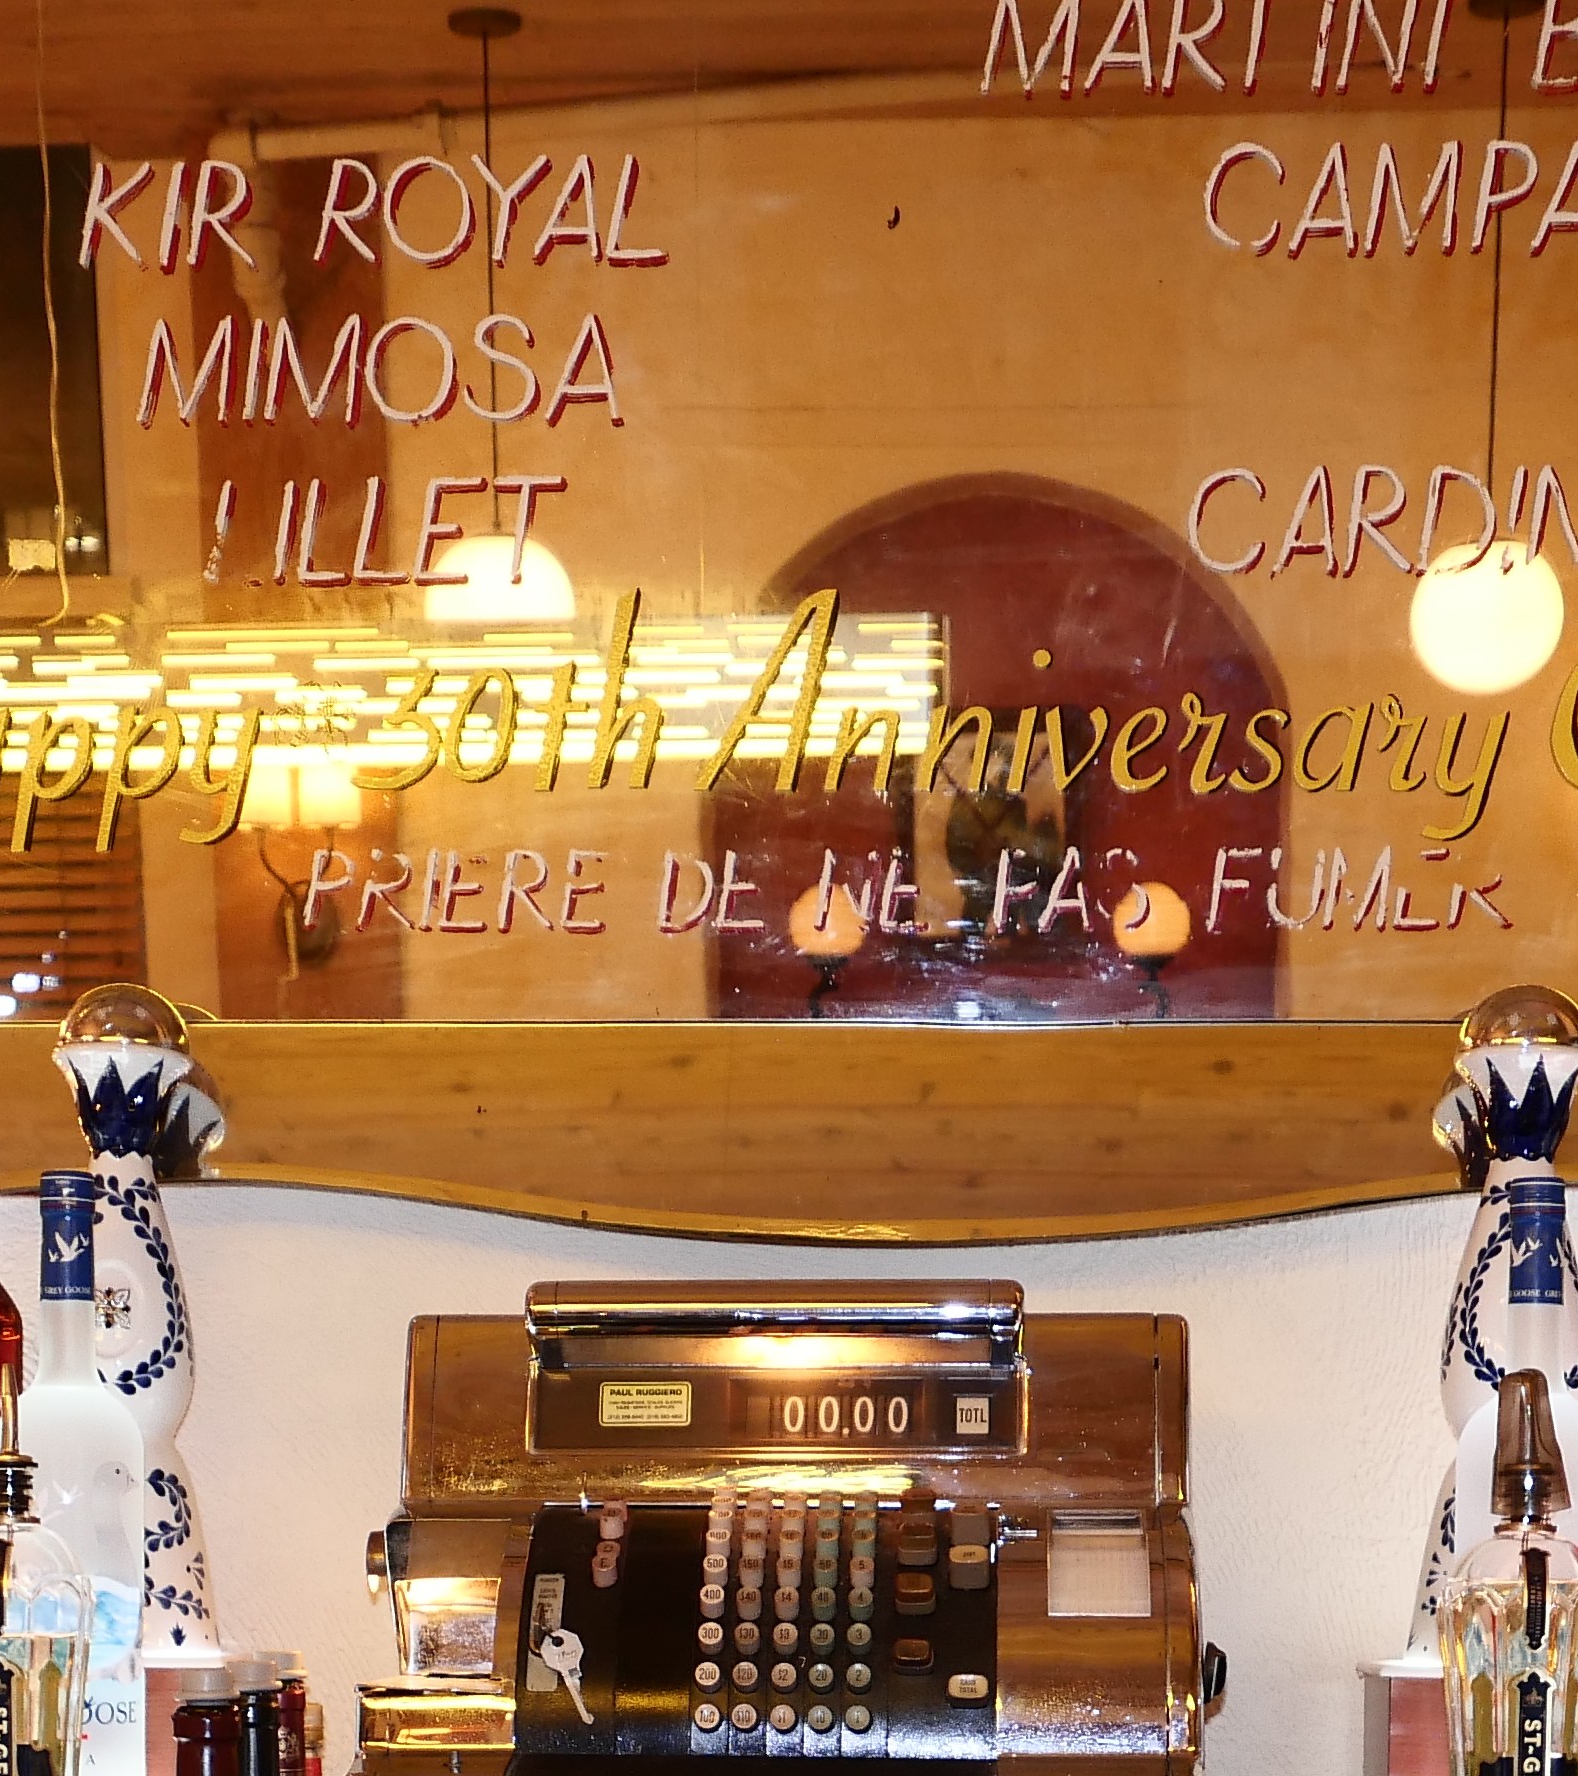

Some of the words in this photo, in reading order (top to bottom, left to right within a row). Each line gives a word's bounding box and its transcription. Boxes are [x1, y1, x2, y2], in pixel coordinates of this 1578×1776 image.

[79, 155, 259, 274] KIR
[313, 152, 672, 270] ROYAL
[136, 310, 627, 430] MIMOSA
[351, 587, 665, 791] 30th
[694, 588, 1511, 841] Anniversary
[657, 848, 766, 936] DE
[608, 1388, 633, 1397] PAUL
[958, 1406, 988, 1424] TOTL
[706, 1557, 724, 1569] 500
[703, 1589, 721, 1600] 400
[701, 1628, 719, 1640] 300
[698, 1668, 716, 1680] 200
[815, 1670, 828, 1681] 20
[855, 1670, 862, 1681] 2
[699, 1710, 715, 1723] 100
